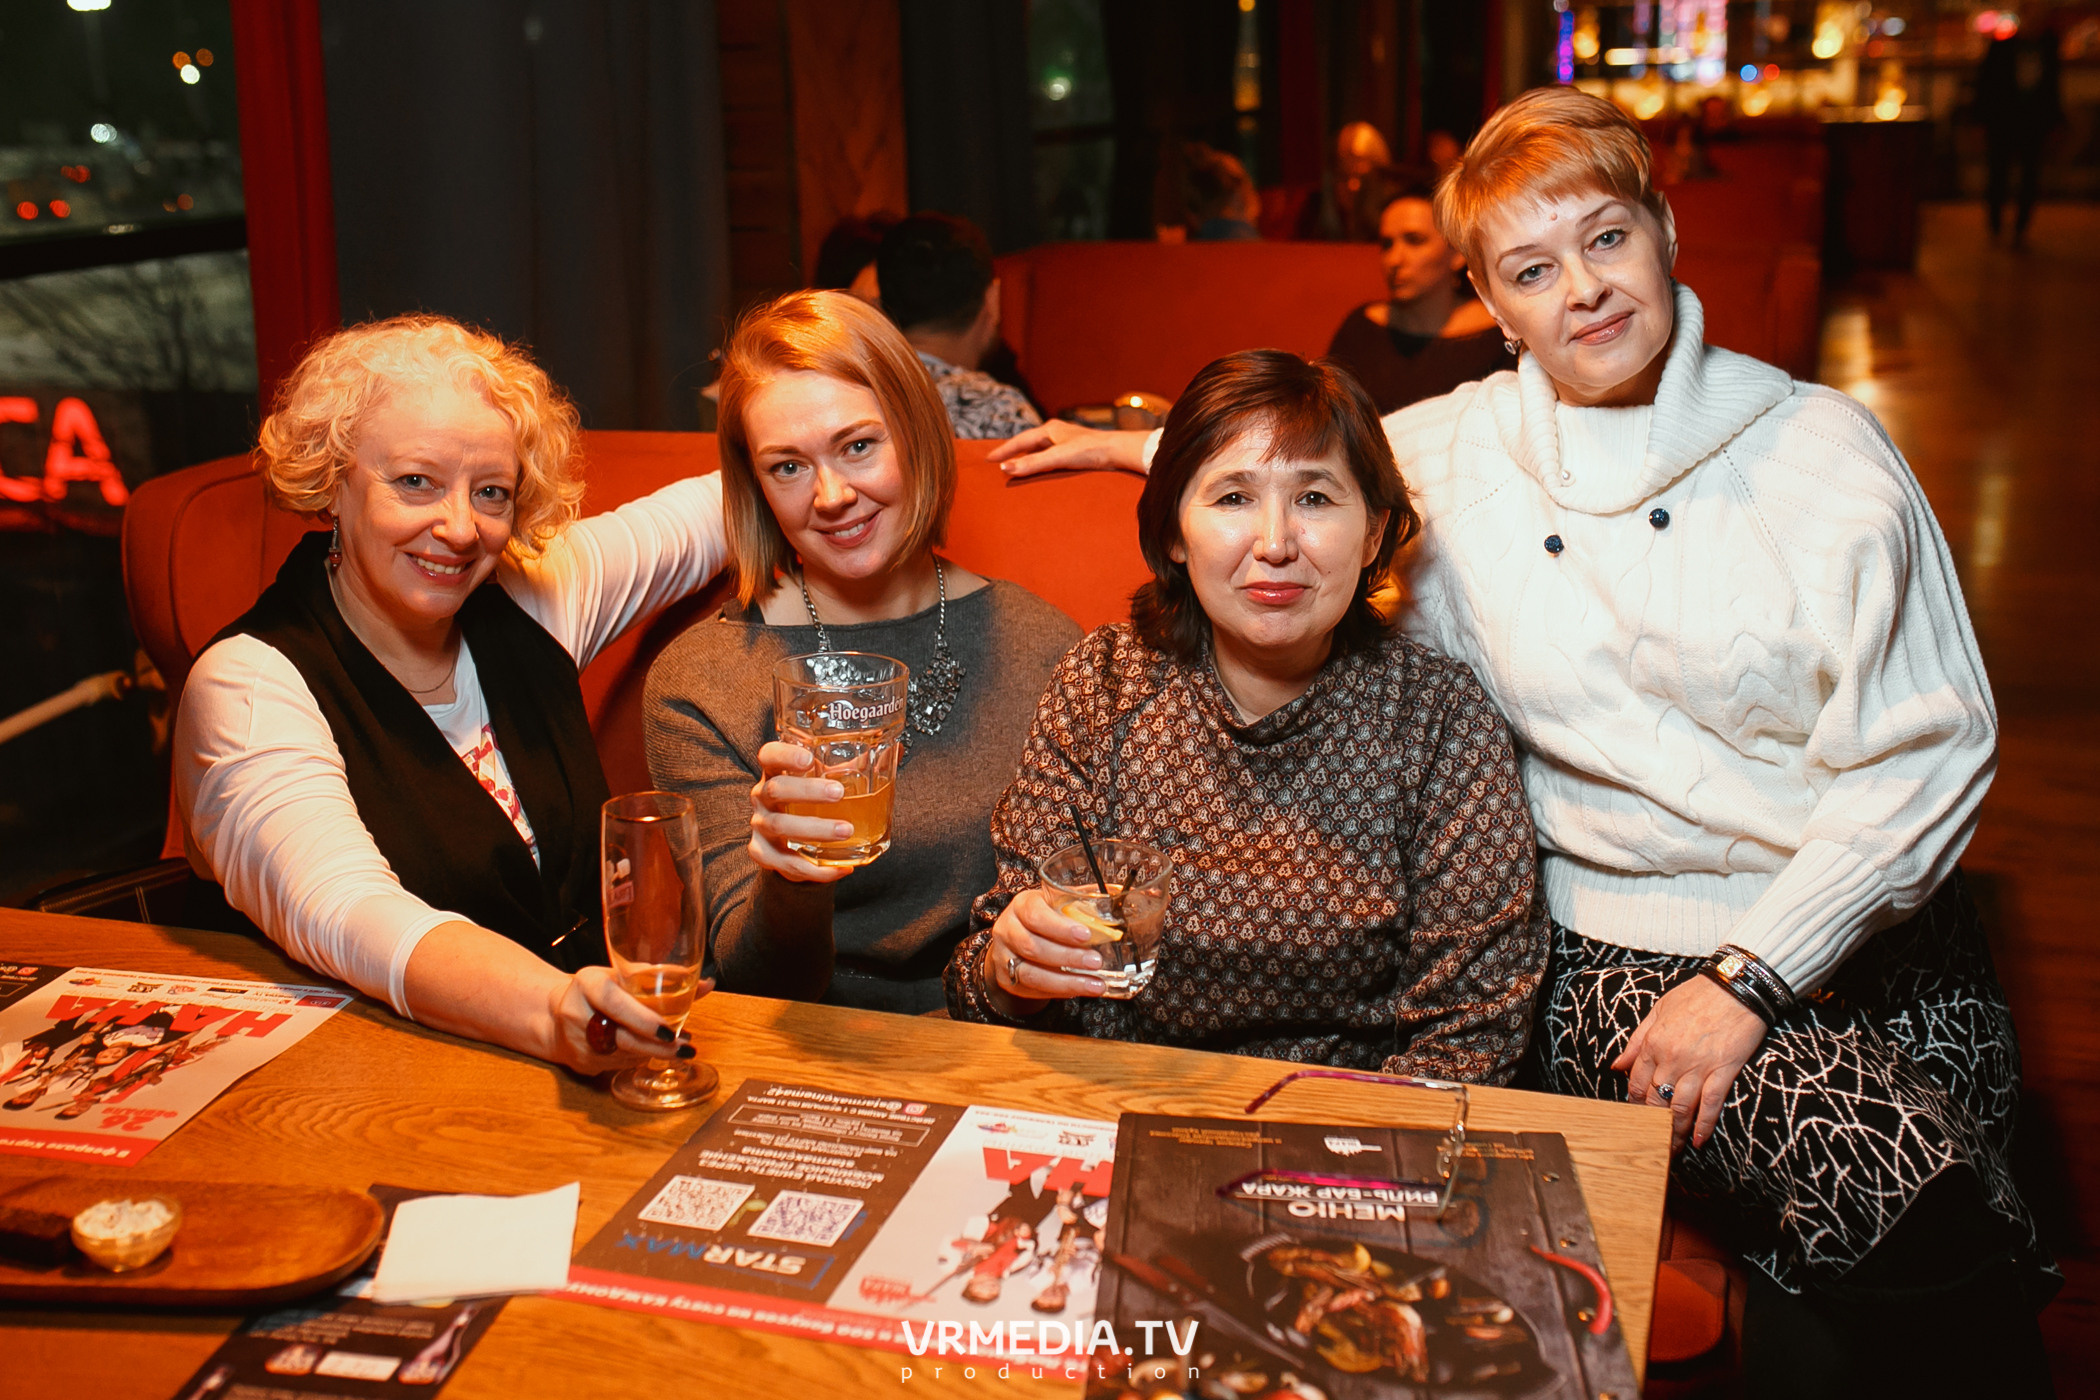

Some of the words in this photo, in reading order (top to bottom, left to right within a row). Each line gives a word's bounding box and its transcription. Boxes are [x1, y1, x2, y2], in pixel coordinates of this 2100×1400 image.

[829, 696, 904, 722] Hoegaarden
[97, 1115, 154, 1132] 26
[46, 1143, 117, 1157] феврале
[742, 1146, 855, 1168] starmaxcinema
[698, 1150, 794, 1171] ПРИЛОЖЕНИЕ
[698, 1159, 743, 1171] ЧЕРЕЗ
[744, 1165, 804, 1180] БИЛЕТЫ
[795, 1163, 884, 1182] МОБИЛЬНОЕ
[805, 1174, 872, 1189] ПОКУПАЙ
[1242, 1183, 1311, 1198] ЖАРА
[1317, 1188, 1449, 1204] РИЛЬ-БАР
[1288, 1201, 1405, 1222] МЕНЮ
[615, 1234, 806, 1275] STARMAX
[668, 1295, 725, 1315] счету
[727, 1305, 753, 1320] на
